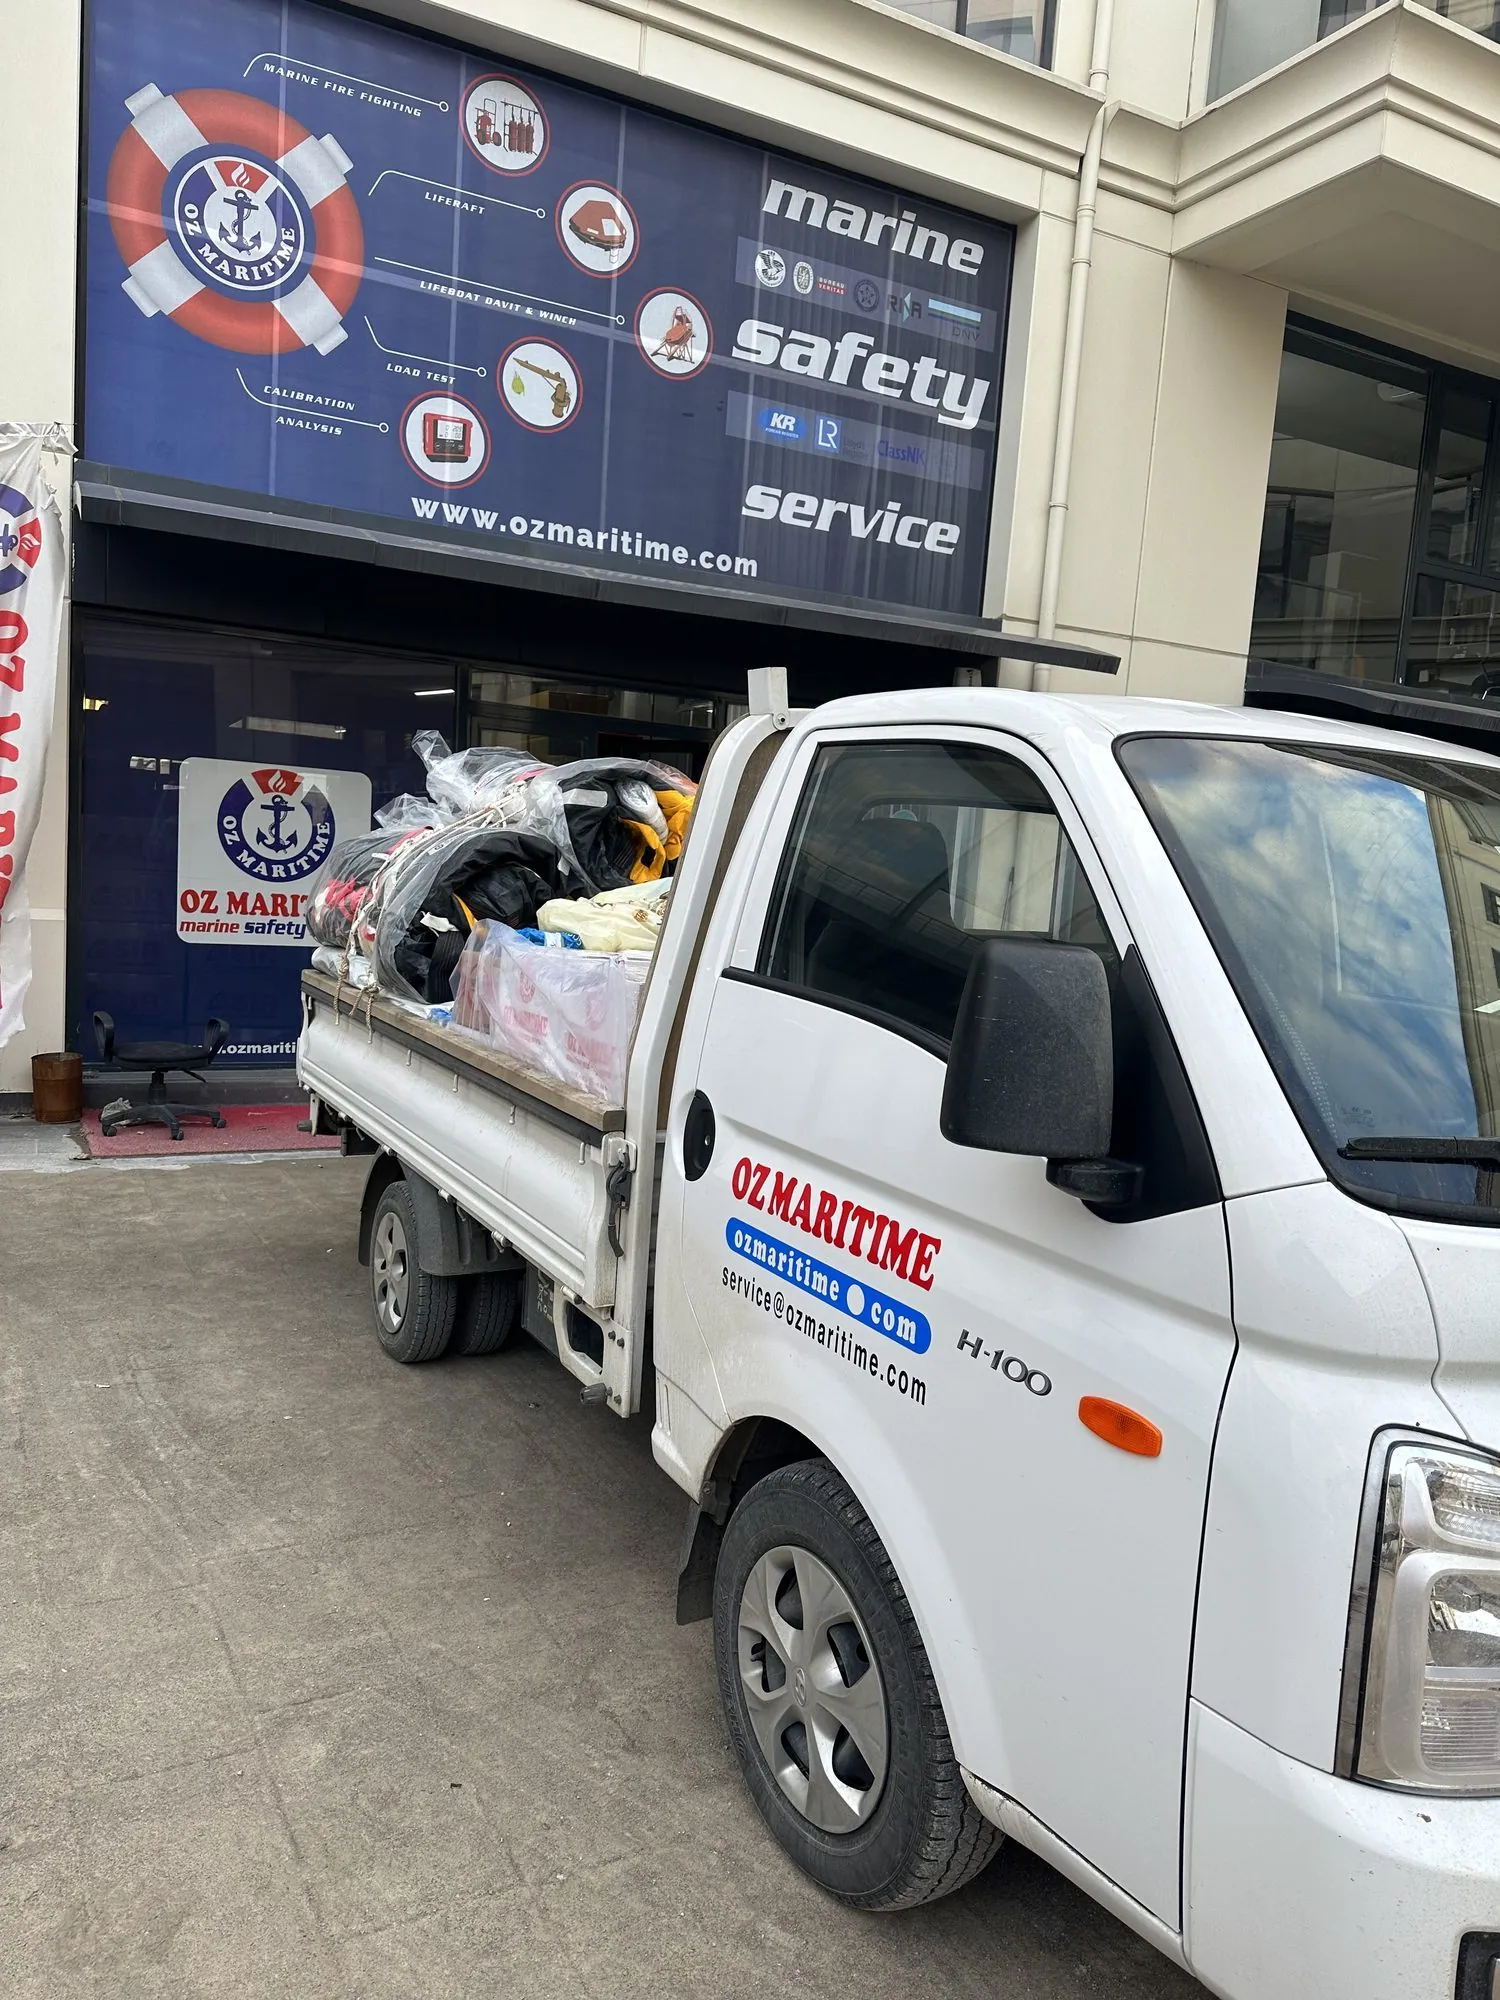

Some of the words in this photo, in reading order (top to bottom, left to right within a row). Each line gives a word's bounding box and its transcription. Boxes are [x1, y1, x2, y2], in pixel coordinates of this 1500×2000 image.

[263, 63, 318, 86] MARINE
[324, 81, 355, 97] FIRE
[360, 92, 422, 117] FIGHTING
[424, 192, 486, 215] LIFERAFT
[761, 179, 985, 276] marine
[183, 203, 199, 237] OZ
[197, 226, 295, 281] MARITIME
[420, 280, 480, 302] LIFEBOAT
[485, 296, 521, 312] DAVIT
[525, 306, 534, 315] &
[539, 310, 577, 325] WINCH
[263, 385, 355, 411] CALIBRATION
[386, 363, 420, 377] LOAD
[426, 371, 456, 385] TEST
[731, 319, 991, 430] safety
[275, 416, 343, 436] ANALYSIS
[770, 412, 796, 432] KR
[411, 497, 758, 577] www.ozmaritime.com
[741, 484, 961, 555] service
[223, 815, 241, 846] OZ
[236, 822, 330, 878] MARITIME
[180, 889, 218, 914] OZ
[179, 919, 240, 933] marine
[244, 919, 307, 940] safety
[722, 1266, 927, 1406] service@ozmaritime.com
[956, 1329, 1053, 1396] H-100
